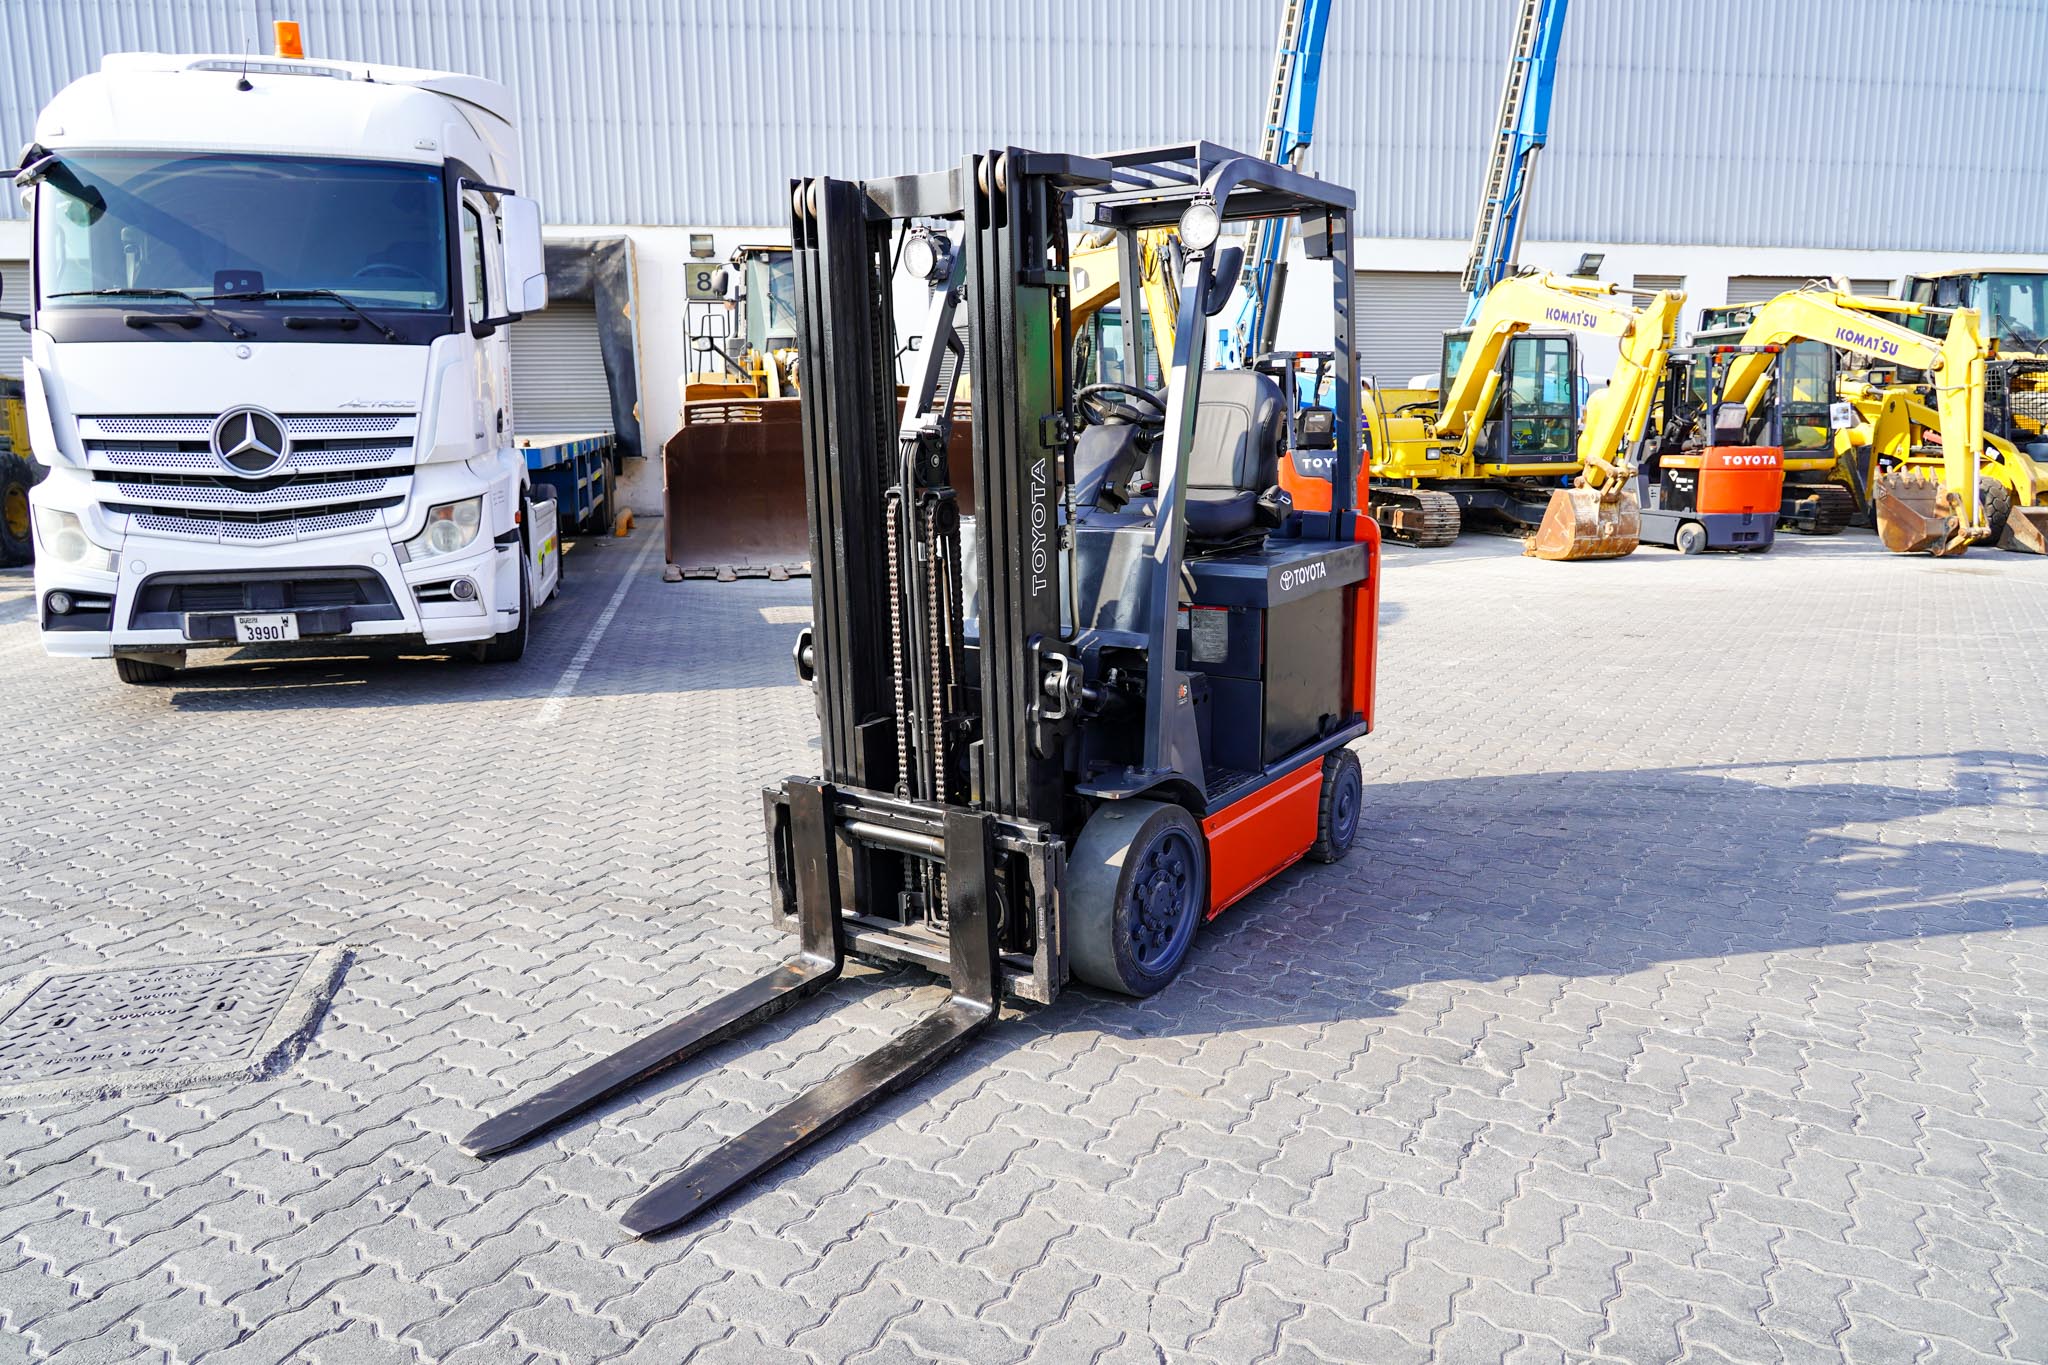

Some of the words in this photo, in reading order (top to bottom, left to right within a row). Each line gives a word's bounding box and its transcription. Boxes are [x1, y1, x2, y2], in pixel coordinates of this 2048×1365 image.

[697, 271, 712, 292] 8
[1545, 307, 1597, 328] KOMATSU
[1835, 327, 1899, 356] KOMATSU
[1302, 457, 1338, 470] TOY
[1722, 455, 1777, 466] TOYOTA
[1031, 457, 1047, 597] TOYOTA
[1293, 561, 1327, 586] TOYOTA
[247, 625, 285, 641] 39901
